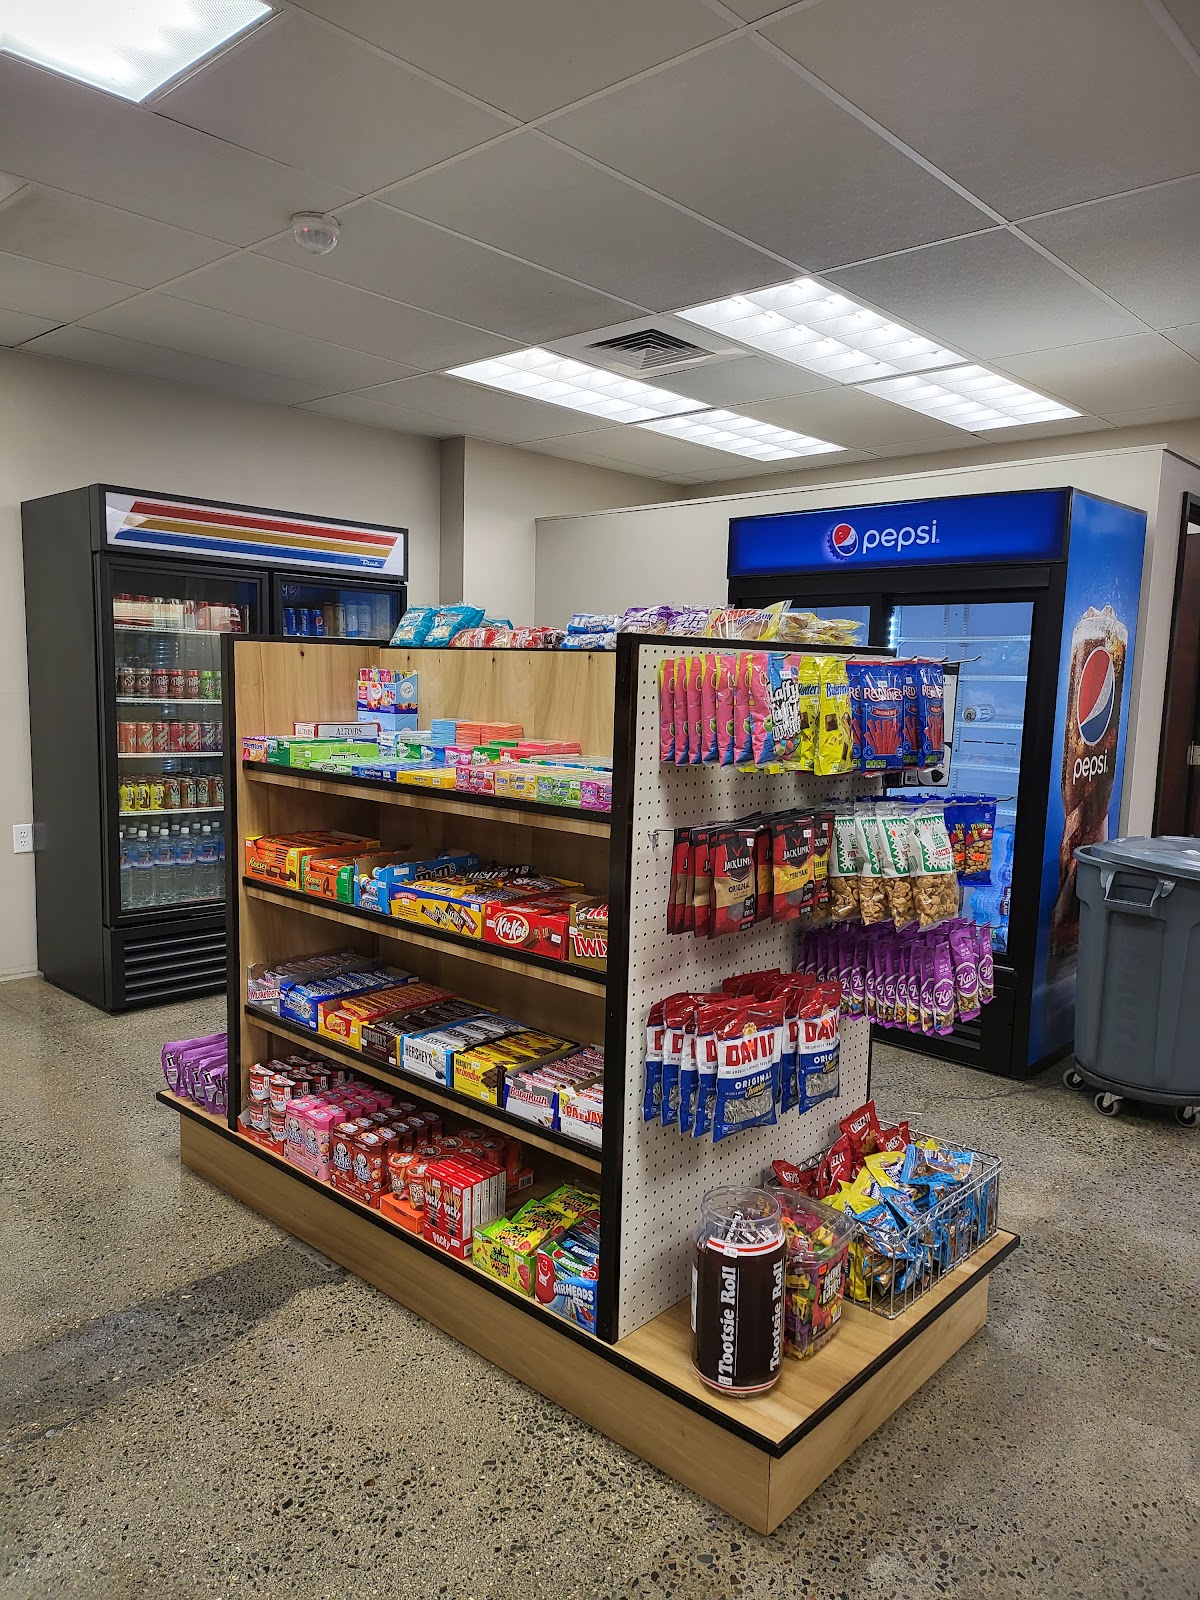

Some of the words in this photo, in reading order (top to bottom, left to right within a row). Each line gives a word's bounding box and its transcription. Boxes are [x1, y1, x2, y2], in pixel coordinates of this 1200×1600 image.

[862, 519, 937, 554] pepsi
[336, 727, 362, 737] ALTOIDS
[1072, 749, 1107, 785] pepsi
[248, 857, 268, 870] Reese's
[305, 873, 322, 885] Reese's
[405, 1044, 433, 1065] HERSHEY'S
[725, 1032, 775, 1067] DAVID
[734, 1072, 772, 1090] ORIGINAL
[553, 1281, 594, 1302] AIRHEADS
[720, 1266, 737, 1306] Roll
[772, 1259, 783, 1301] Roll
[718, 1308, 735, 1375] Tootsie
[769, 1302, 782, 1372] Tootsie
